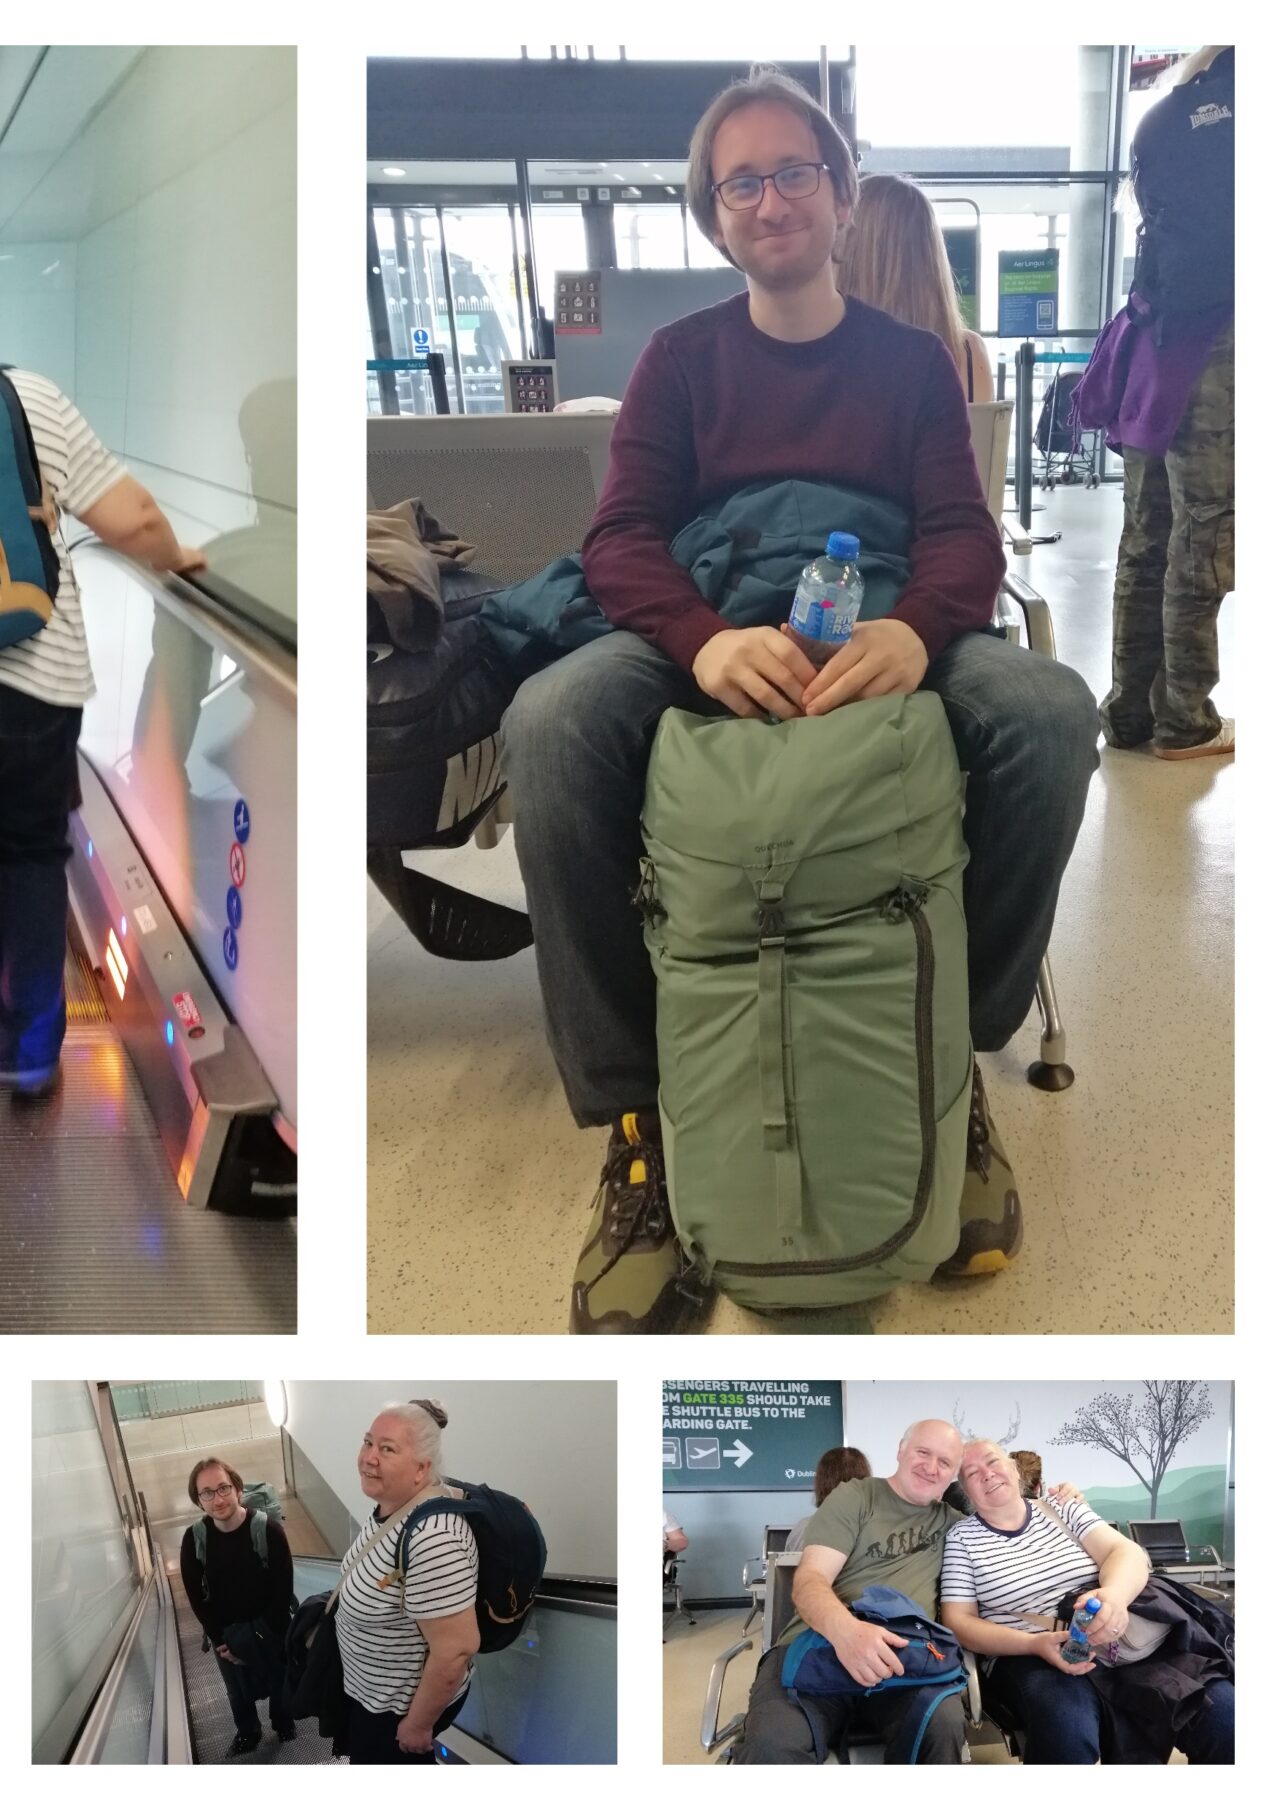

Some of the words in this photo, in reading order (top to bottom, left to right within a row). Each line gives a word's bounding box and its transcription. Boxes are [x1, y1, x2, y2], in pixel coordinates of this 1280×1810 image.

[1025, 260, 1045, 269] Lingus
[781, 1236, 794, 1247] 35
[732, 1381, 810, 1393] TRAVELLING
[683, 1392, 718, 1404] GATE
[719, 1393, 744, 1404] 335
[746, 1394, 798, 1405] SHOULD
[800, 1395, 831, 1406] TAKE
[672, 1405, 732, 1417] SHUTTLE
[734, 1406, 761, 1418] BUS
[762, 1407, 780, 1418] TO
[781, 1407, 806, 1418] THE
[716, 1419, 753, 1430] GATE.
